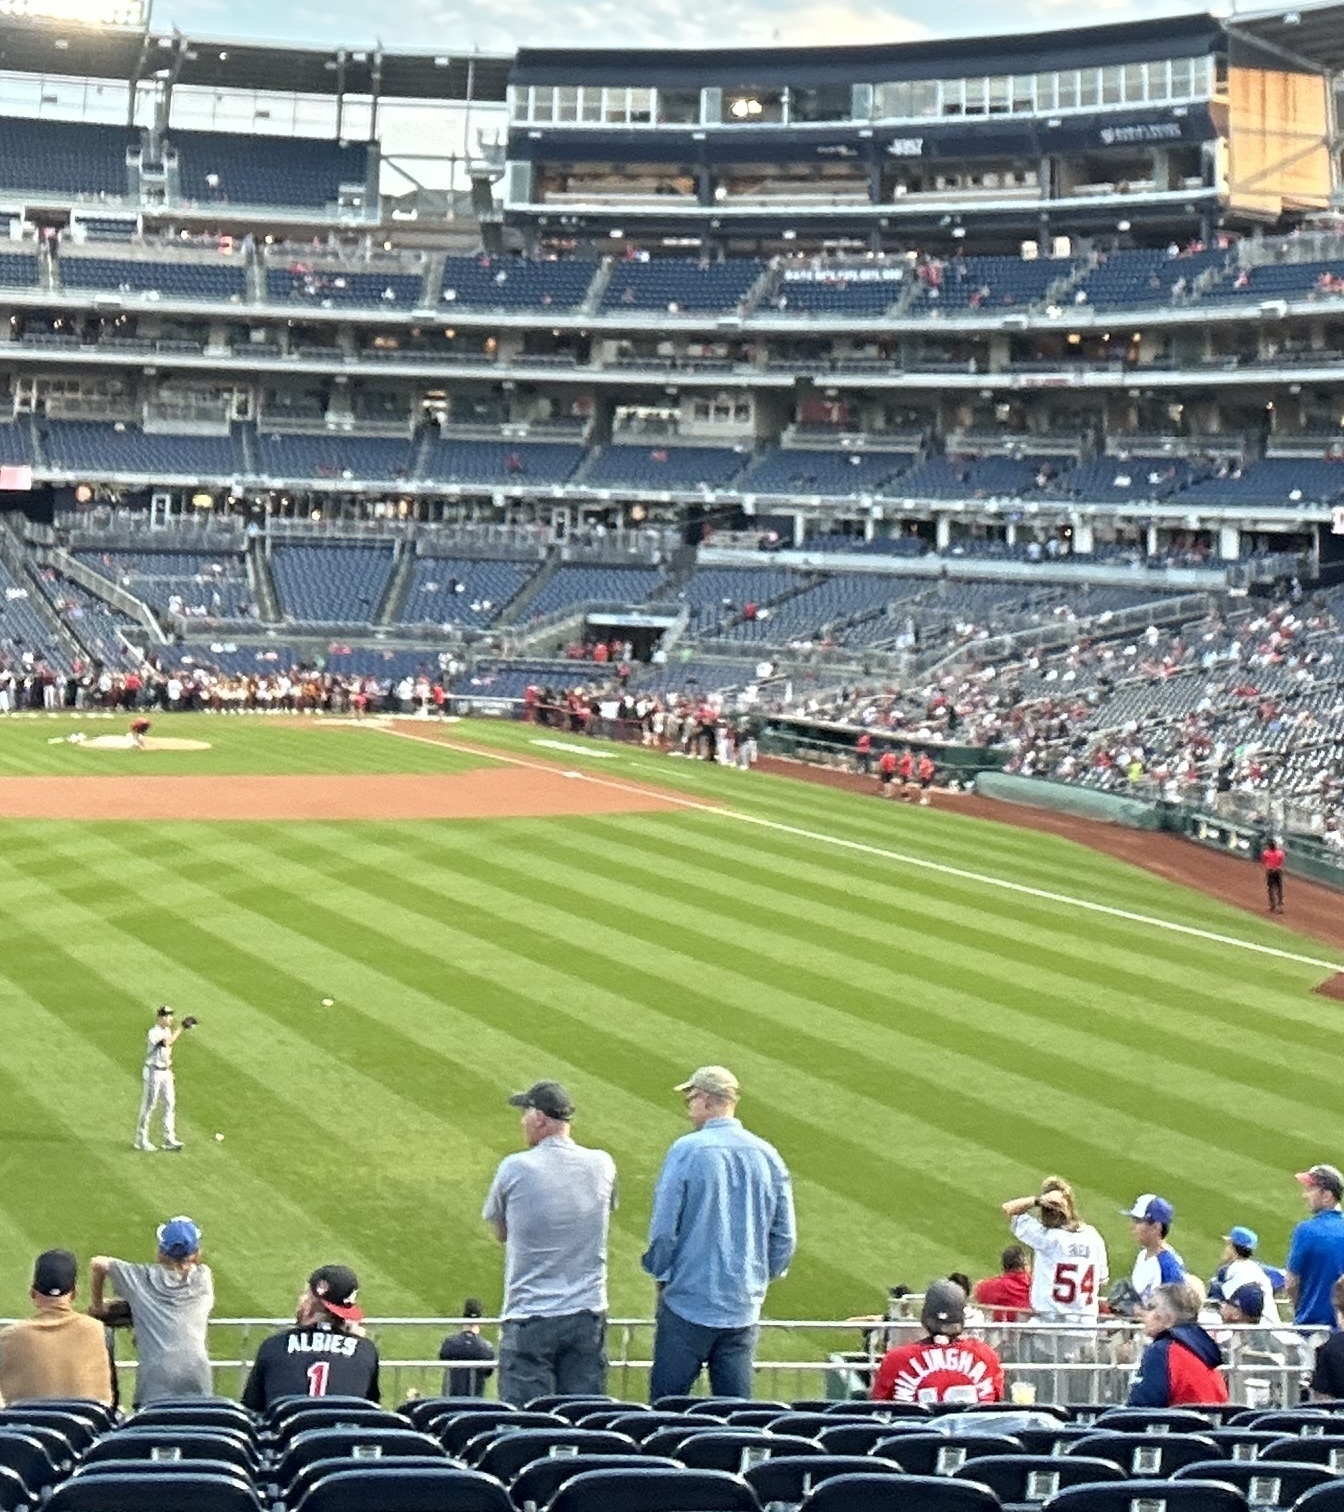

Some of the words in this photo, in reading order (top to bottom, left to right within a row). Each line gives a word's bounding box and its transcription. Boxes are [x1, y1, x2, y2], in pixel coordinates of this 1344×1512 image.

[1052, 1262, 1095, 1306] 54
[287, 1332, 358, 1357] ALBIES
[307, 1361, 330, 1398] 1
